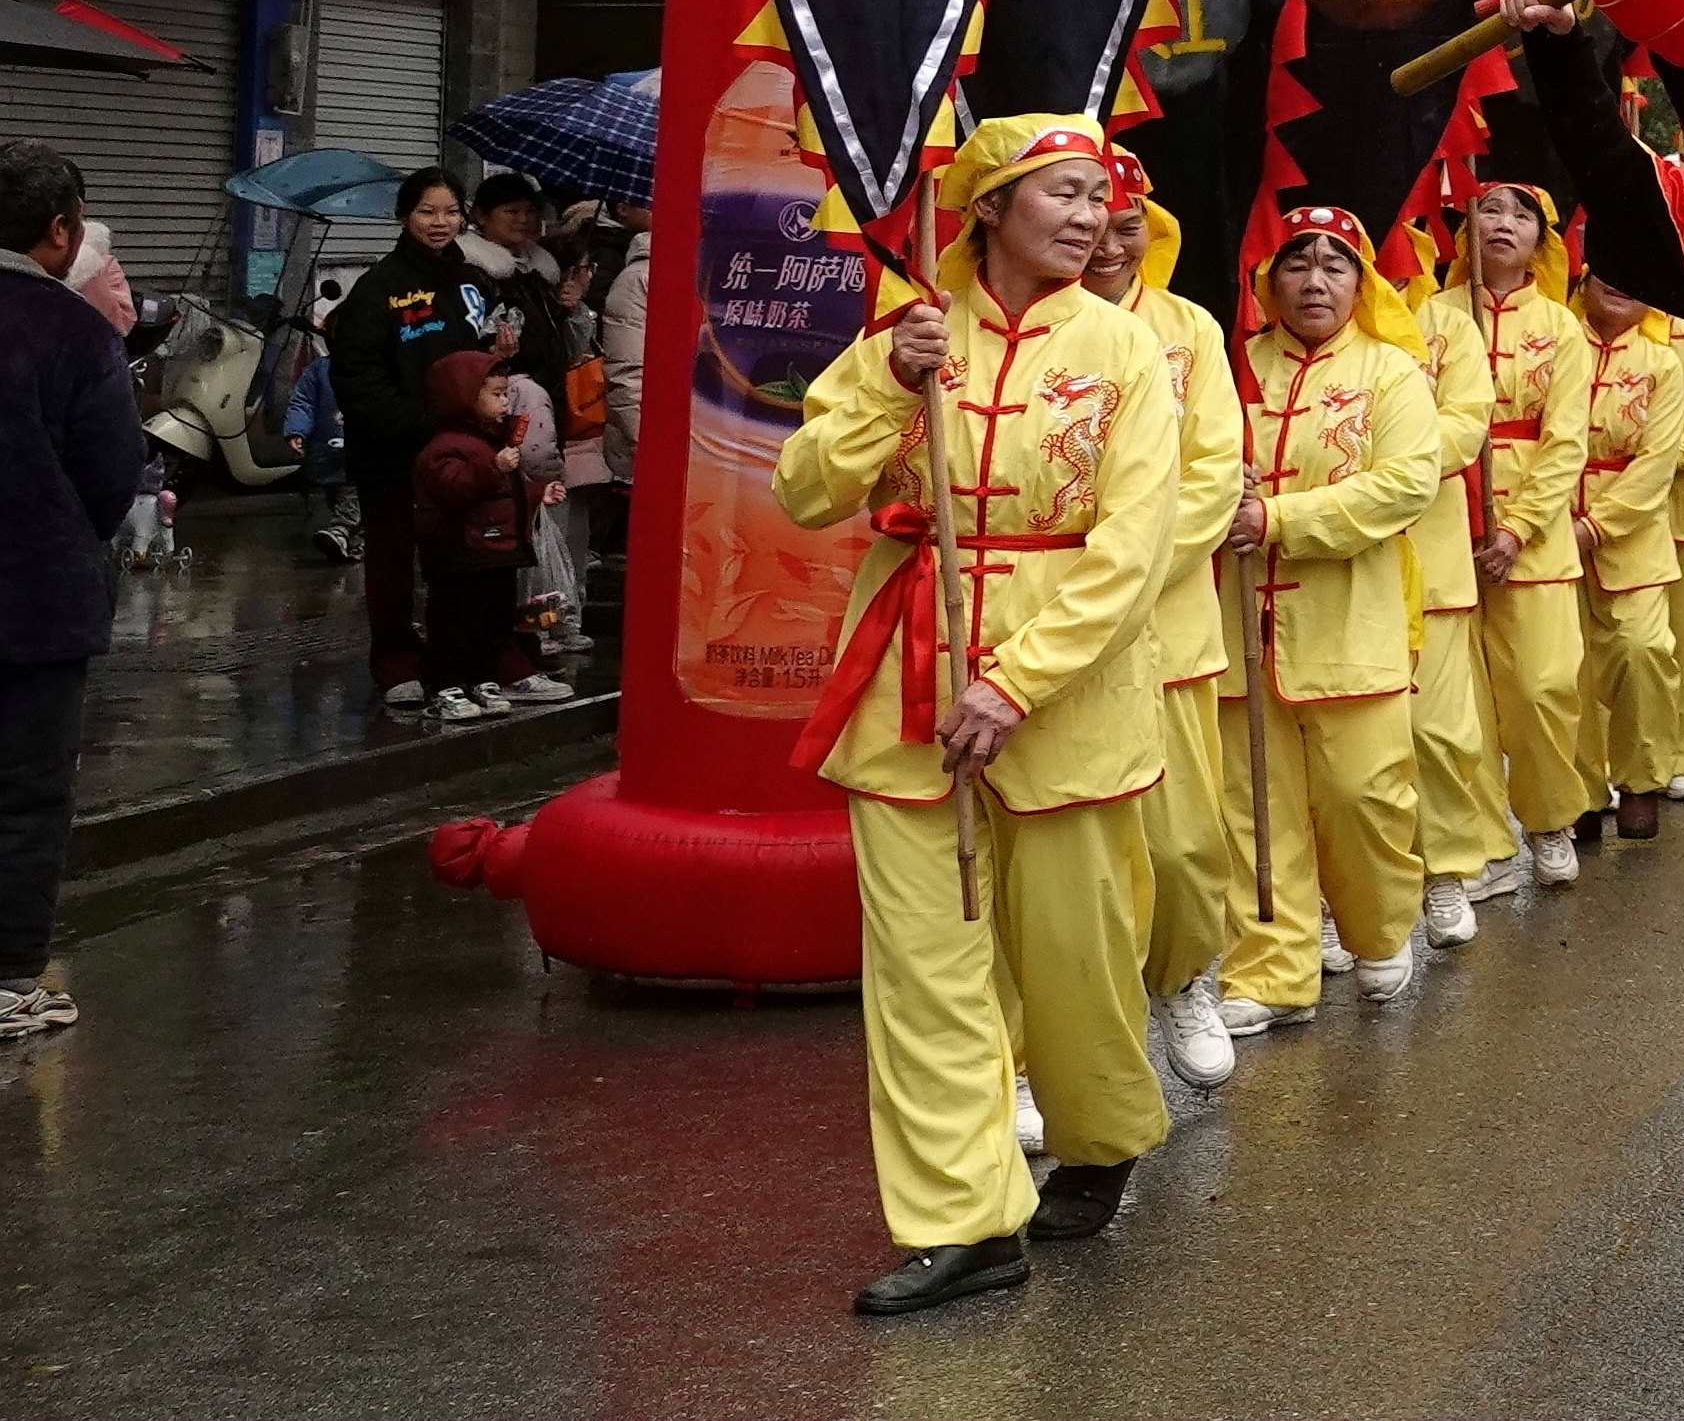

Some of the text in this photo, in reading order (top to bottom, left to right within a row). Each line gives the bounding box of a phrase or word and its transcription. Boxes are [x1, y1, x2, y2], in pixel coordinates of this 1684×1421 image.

[720, 251, 867, 293] 统一阿萨姆
[720, 298, 813, 329] 原味奶茶
